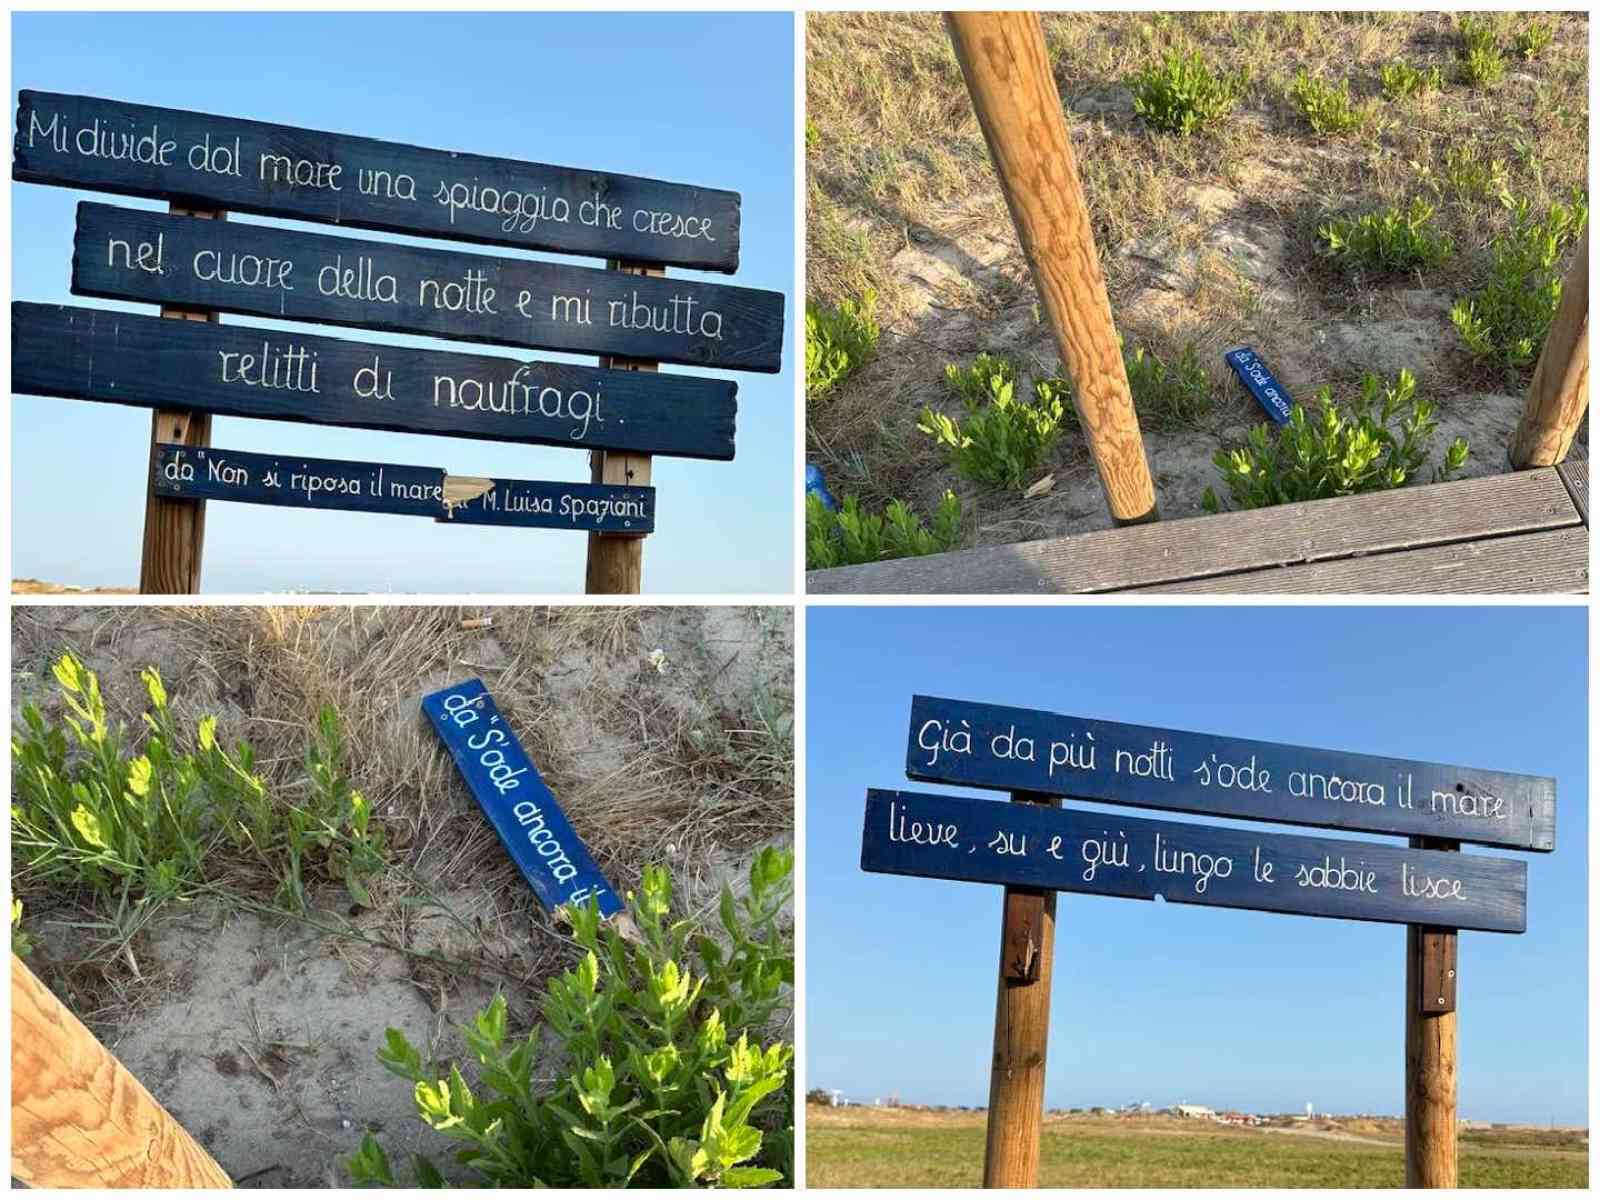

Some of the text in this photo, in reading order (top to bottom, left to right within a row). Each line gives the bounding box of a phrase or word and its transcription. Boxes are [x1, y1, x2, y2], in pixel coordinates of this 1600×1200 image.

[29, 110, 715, 241] Mi divide dal mare una spiaggia che cresce
[107, 231, 723, 340] nel cuore della notte e mi ributta
[218, 341, 320, 393] relitti
[164, 451, 194, 481] da
[262, 460, 282, 489] si
[291, 464, 361, 500] riposa
[369, 468, 384, 496] il
[390, 480, 443, 501] mare
[482, 489, 500, 511] M.
[504, 488, 552, 513] Luisa
[559, 493, 647, 522] Spaziani
[444, 694, 483, 728] da
[513, 801, 578, 884] ancora
[918, 719, 1506, 819] Già da più notti s'ode ancora il mare
[988, 830, 1027, 857] su
[1046, 835, 1064, 860] e
[1155, 833, 1233, 893] lungo
[1254, 845, 1274, 883] le
[1294, 857, 1378, 893] sabbie
[1402, 863, 1467, 901] lisce
